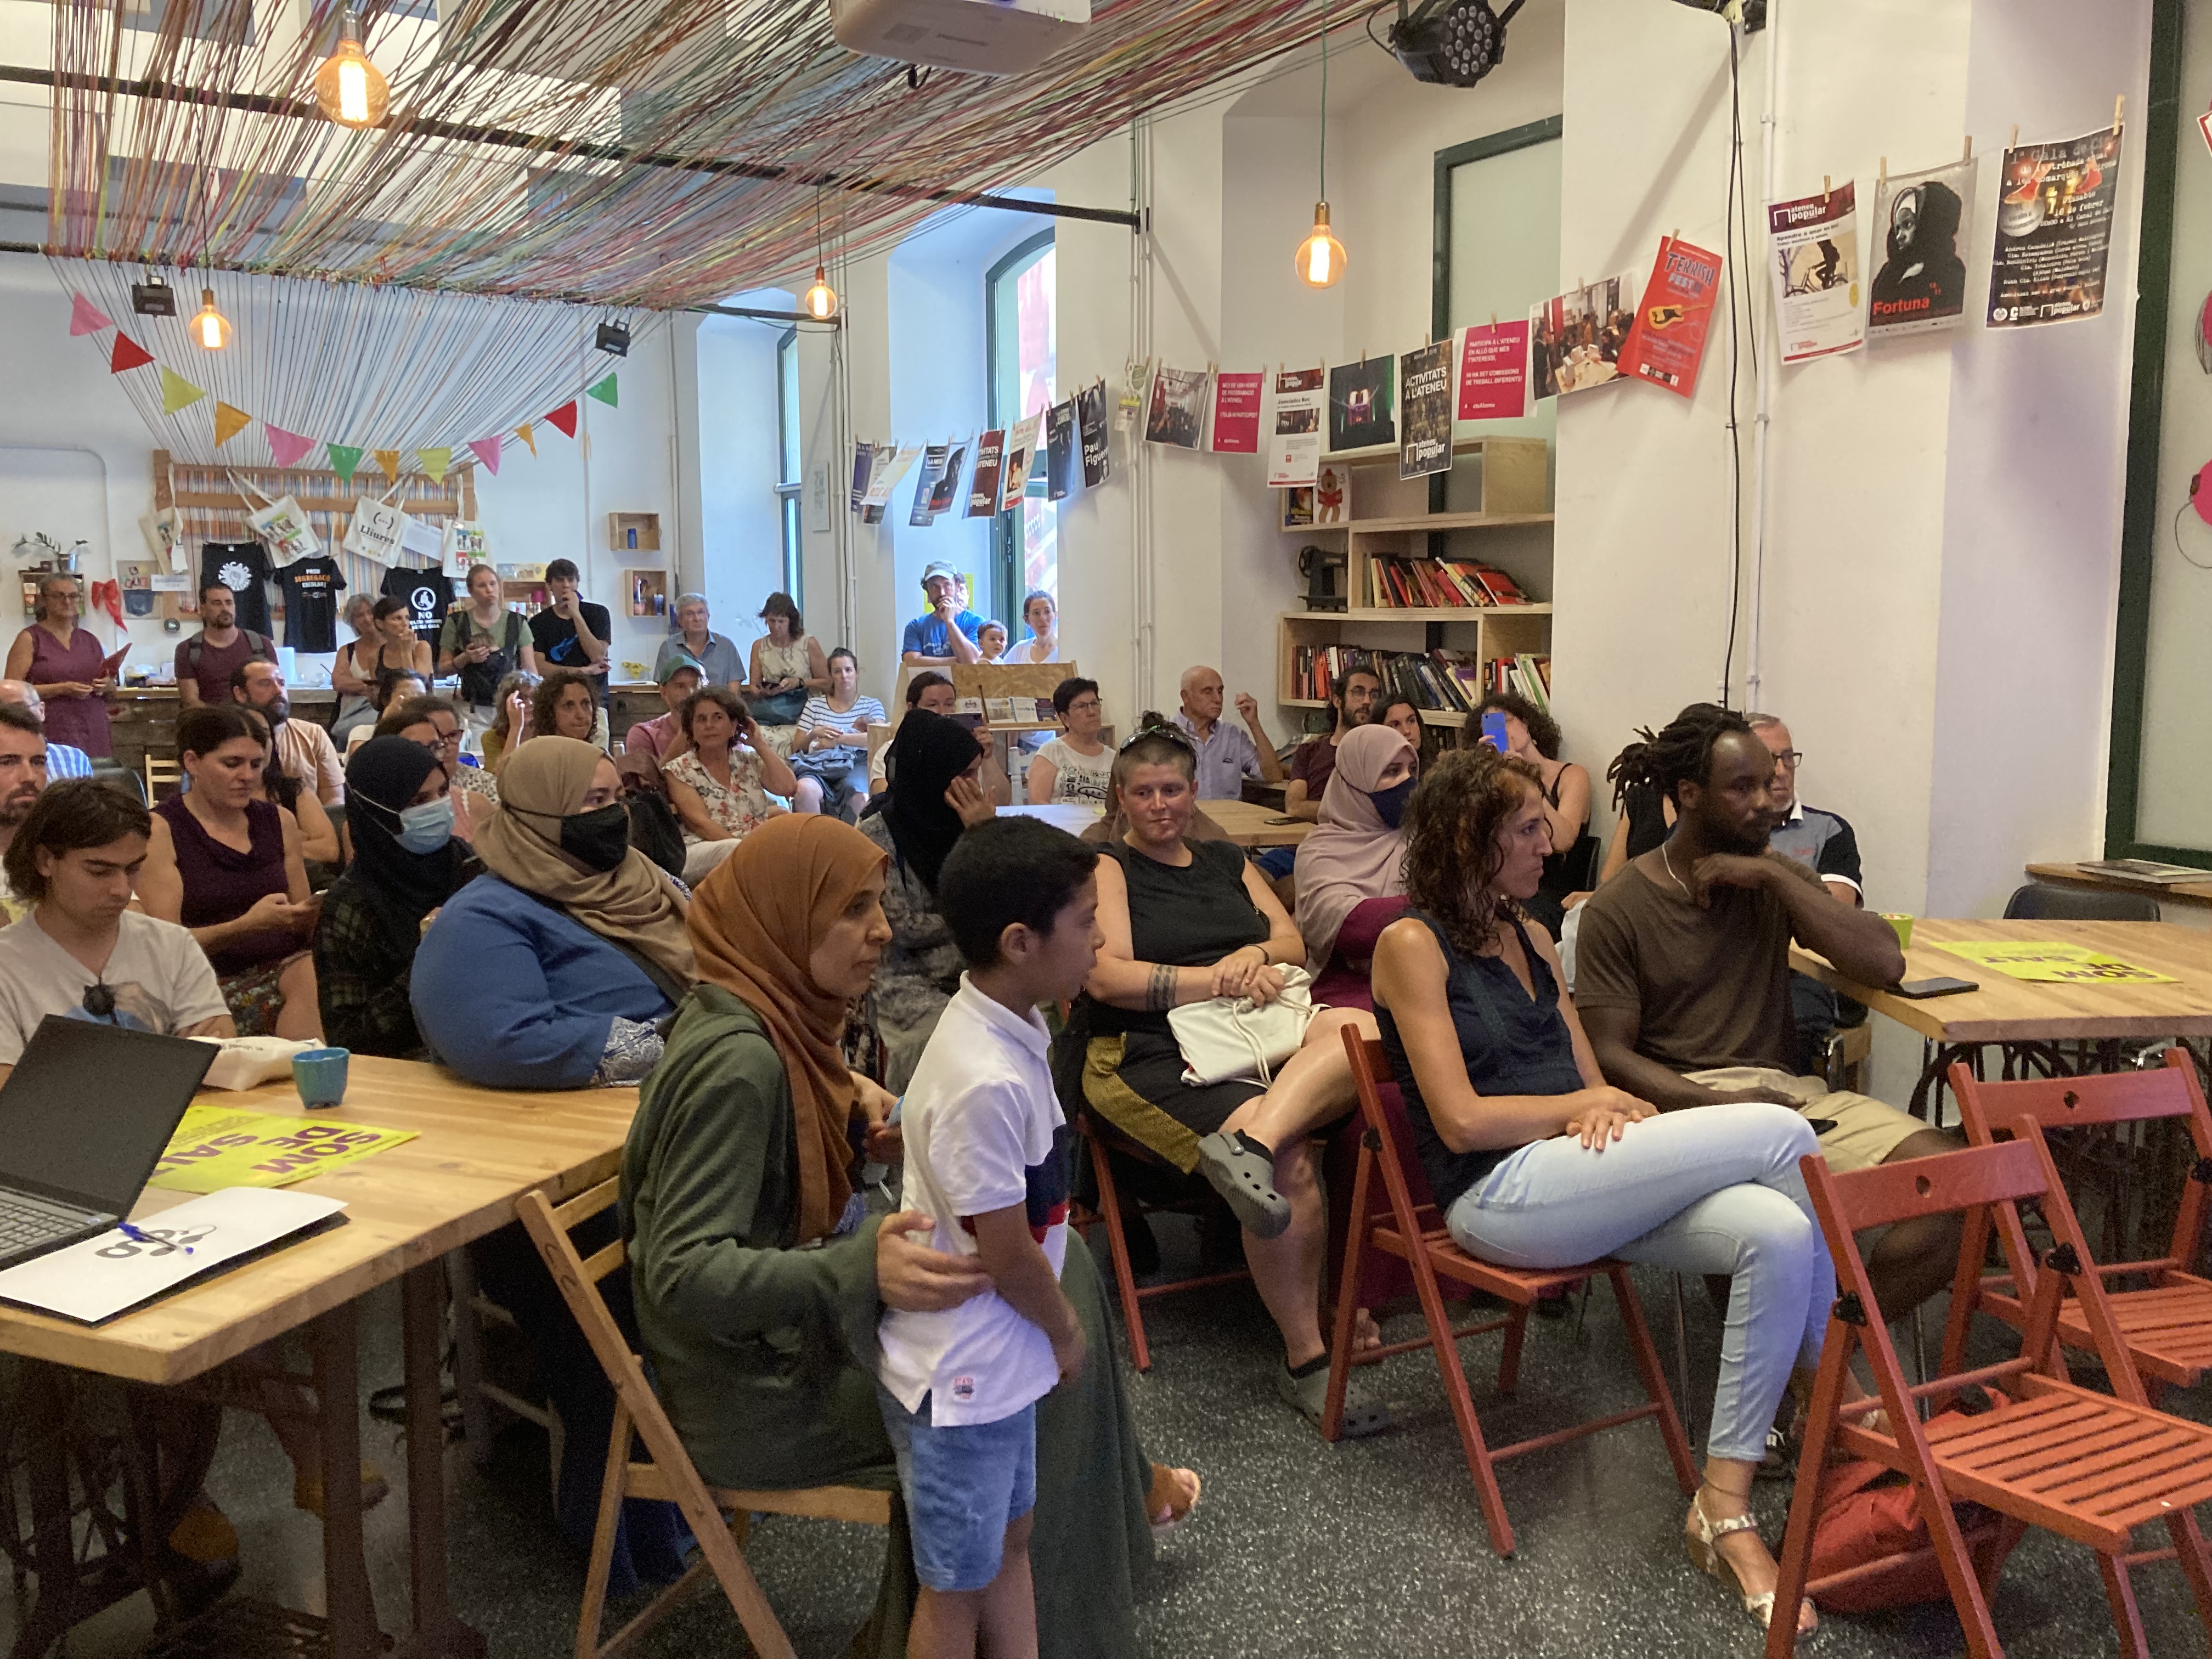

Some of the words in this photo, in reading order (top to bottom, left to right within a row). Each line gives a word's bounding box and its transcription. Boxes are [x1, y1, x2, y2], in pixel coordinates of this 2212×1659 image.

[2031, 149, 2067, 162] Gala
[2073, 144, 2089, 156] de
[2063, 191, 2096, 204] Dissabte
[2068, 205, 2076, 213] de
[2079, 199, 2104, 211] febrer
[1791, 204, 1814, 213] ateneu
[1791, 206, 1826, 222] popular
[1872, 297, 1931, 315] Fortuna
[2053, 304, 2080, 316] popular
[1405, 365, 1447, 388] ACTIVITATS
[1405, 389, 1410, 401] A
[1412, 378, 1447, 399] L'ATENEU
[1084, 441, 1099, 456] Pau
[1418, 443, 1446, 461] popular
[1419, 438, 1436, 449] ateneu
[360, 524, 395, 545] Lliures
[2051, 970, 2158, 979] SOM
[258, 1126, 346, 1150] DE
[251, 1131, 381, 1174] SOM
